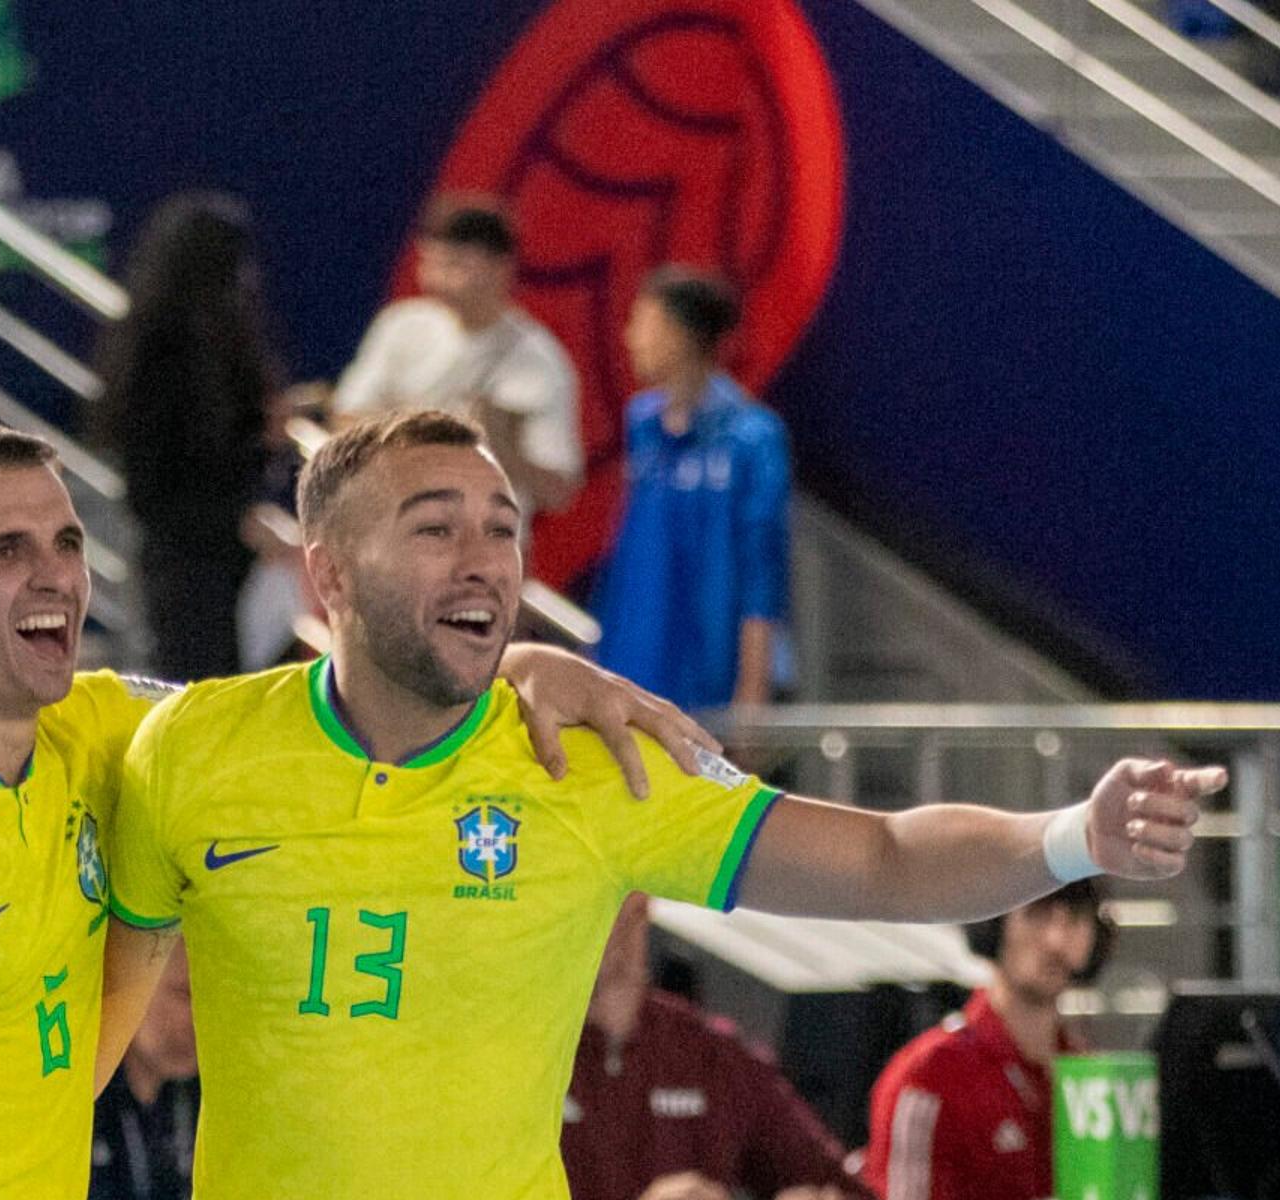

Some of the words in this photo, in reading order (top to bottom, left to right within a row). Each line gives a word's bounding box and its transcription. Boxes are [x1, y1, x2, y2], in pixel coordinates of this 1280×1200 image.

[453, 885, 518, 900] BRASIL
[298, 906, 407, 1020] 13
[35, 963, 71, 1079] 6
[1062, 1076, 1114, 1142] VS
